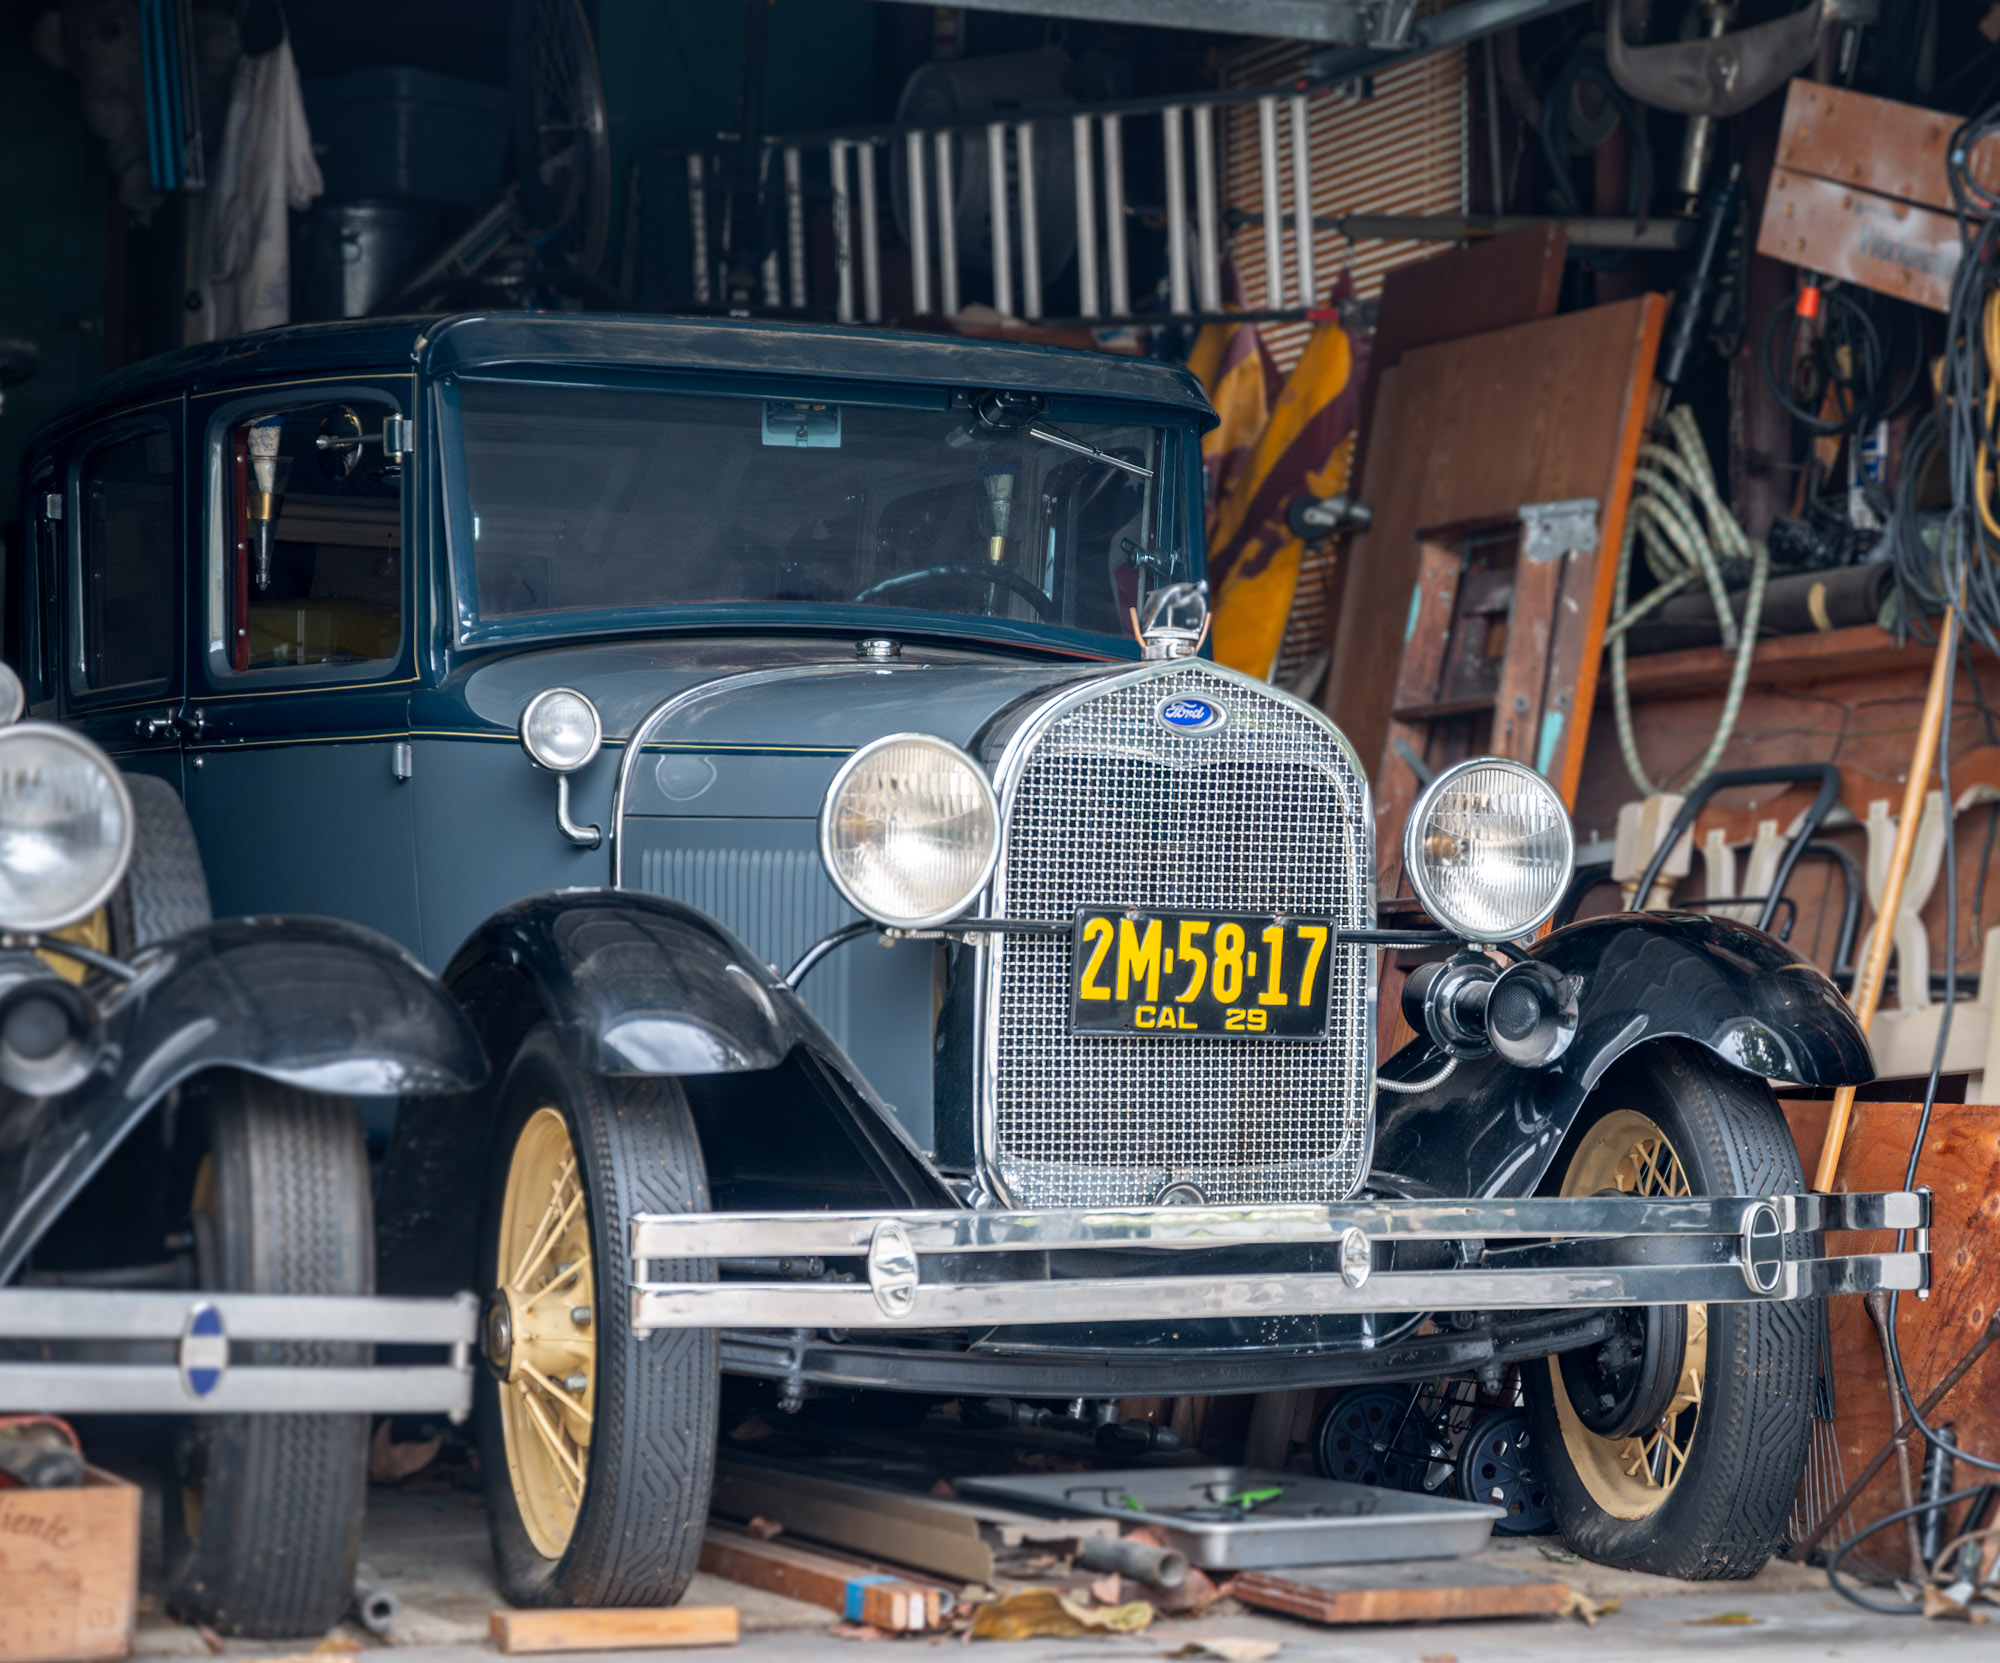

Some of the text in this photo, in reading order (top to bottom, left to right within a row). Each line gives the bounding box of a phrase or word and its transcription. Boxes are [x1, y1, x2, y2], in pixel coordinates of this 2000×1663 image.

[1165, 701, 1205, 719] Ford
[1135, 1005, 1268, 1031] CAL 29
